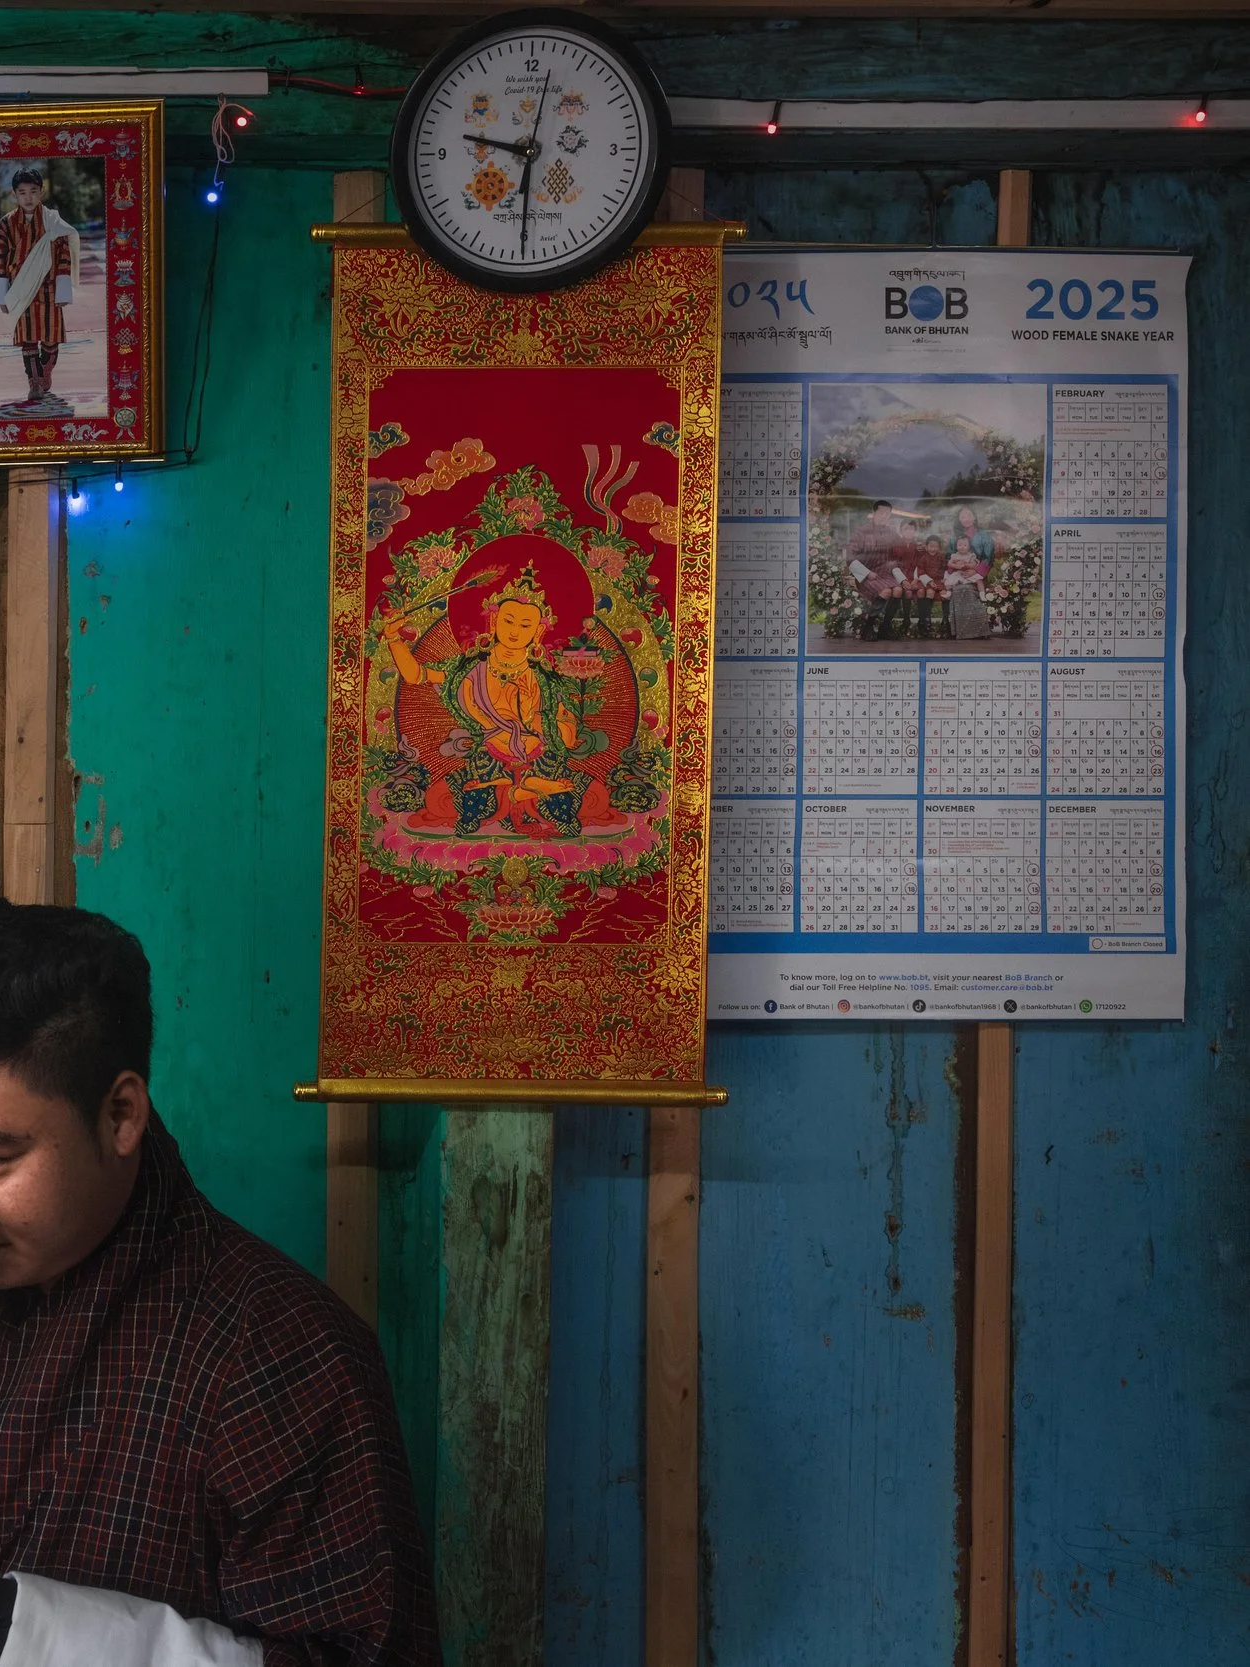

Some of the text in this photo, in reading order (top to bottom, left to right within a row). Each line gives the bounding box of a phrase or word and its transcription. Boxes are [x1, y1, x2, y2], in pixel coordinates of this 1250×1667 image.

[525, 60, 539, 71] 12
[505, 85, 563, 95] Covid-19 fre life
[438, 144, 618, 160] 9 3
[493, 209, 562, 227] བཀྲ་ཤིསབདེ་ལེགས།
[520, 230, 528, 241] 6
[885, 285, 968, 321] BOB
[1026, 279, 1159, 320] 2025
[885, 326, 968, 335] BANK OF BHUTAN
[1012, 330, 1174, 341] WOOD FEMALE SNAKE YEAR
